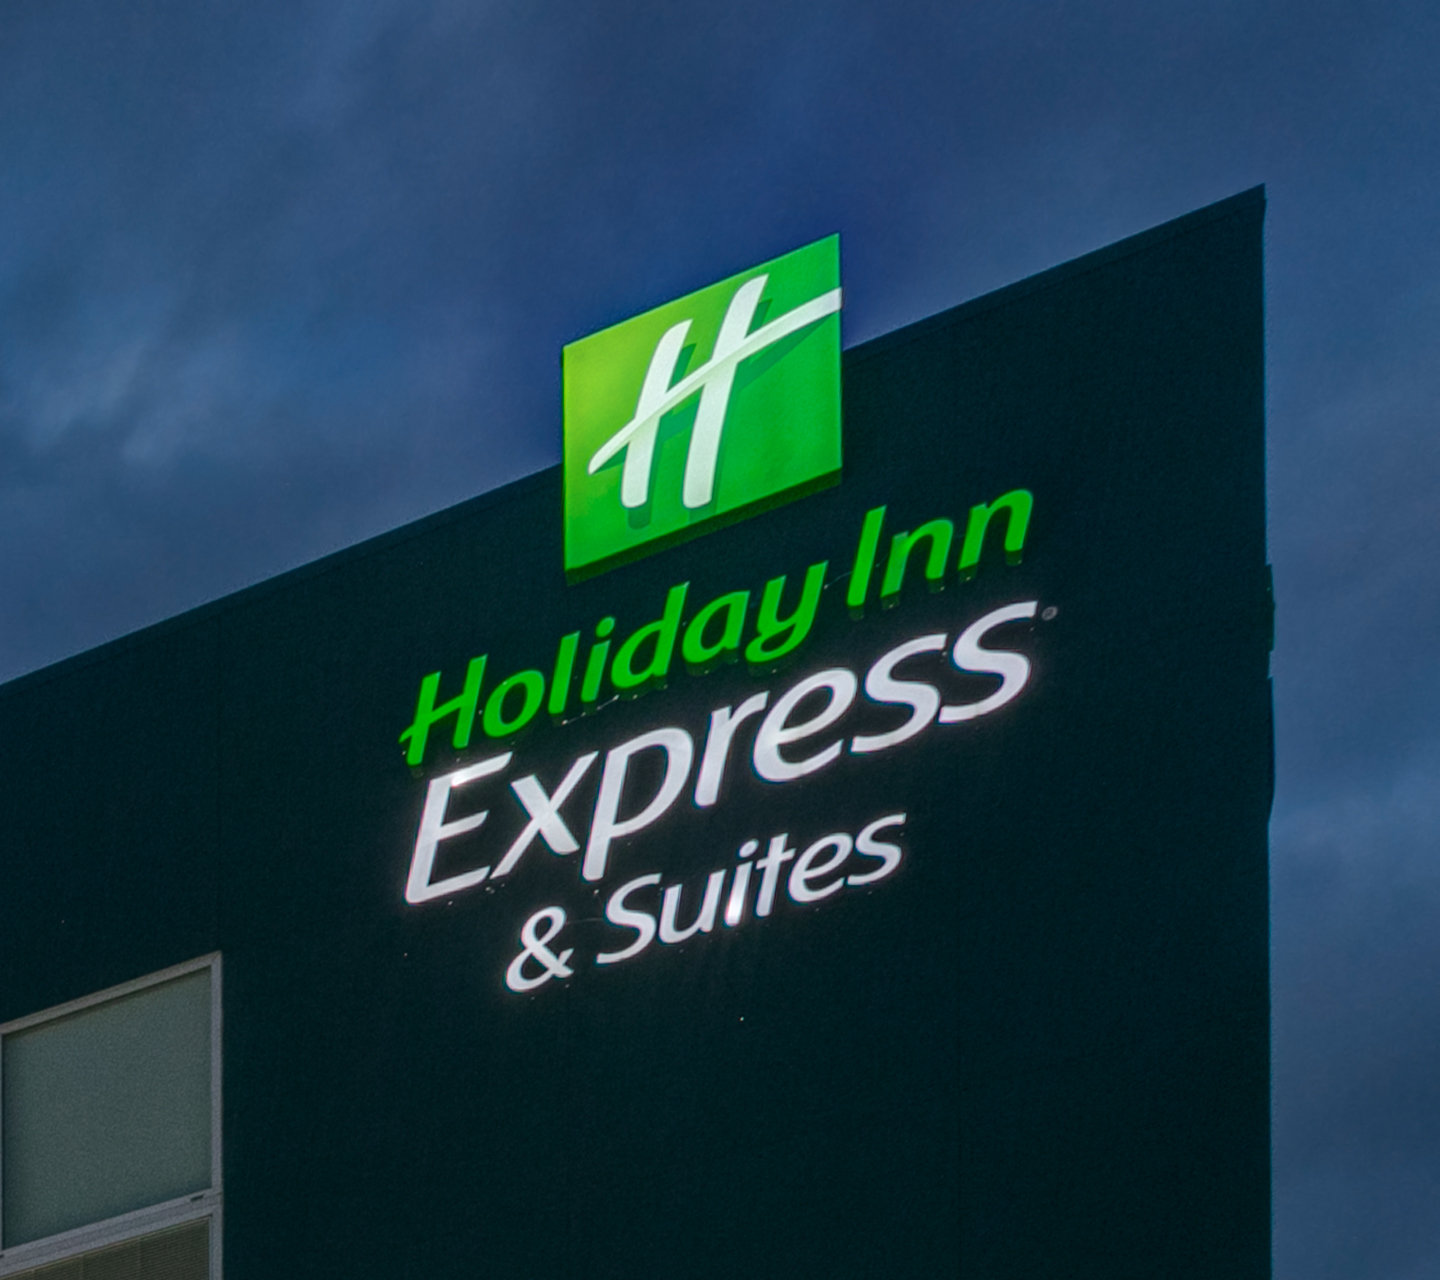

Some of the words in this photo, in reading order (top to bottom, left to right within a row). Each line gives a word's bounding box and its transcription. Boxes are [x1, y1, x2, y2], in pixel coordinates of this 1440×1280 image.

[399, 561, 828, 767] Holiday
[846, 488, 1034, 608] Inn
[405, 600, 1040, 905] Express
[504, 905, 574, 993] &
[595, 813, 907, 964] Suites
